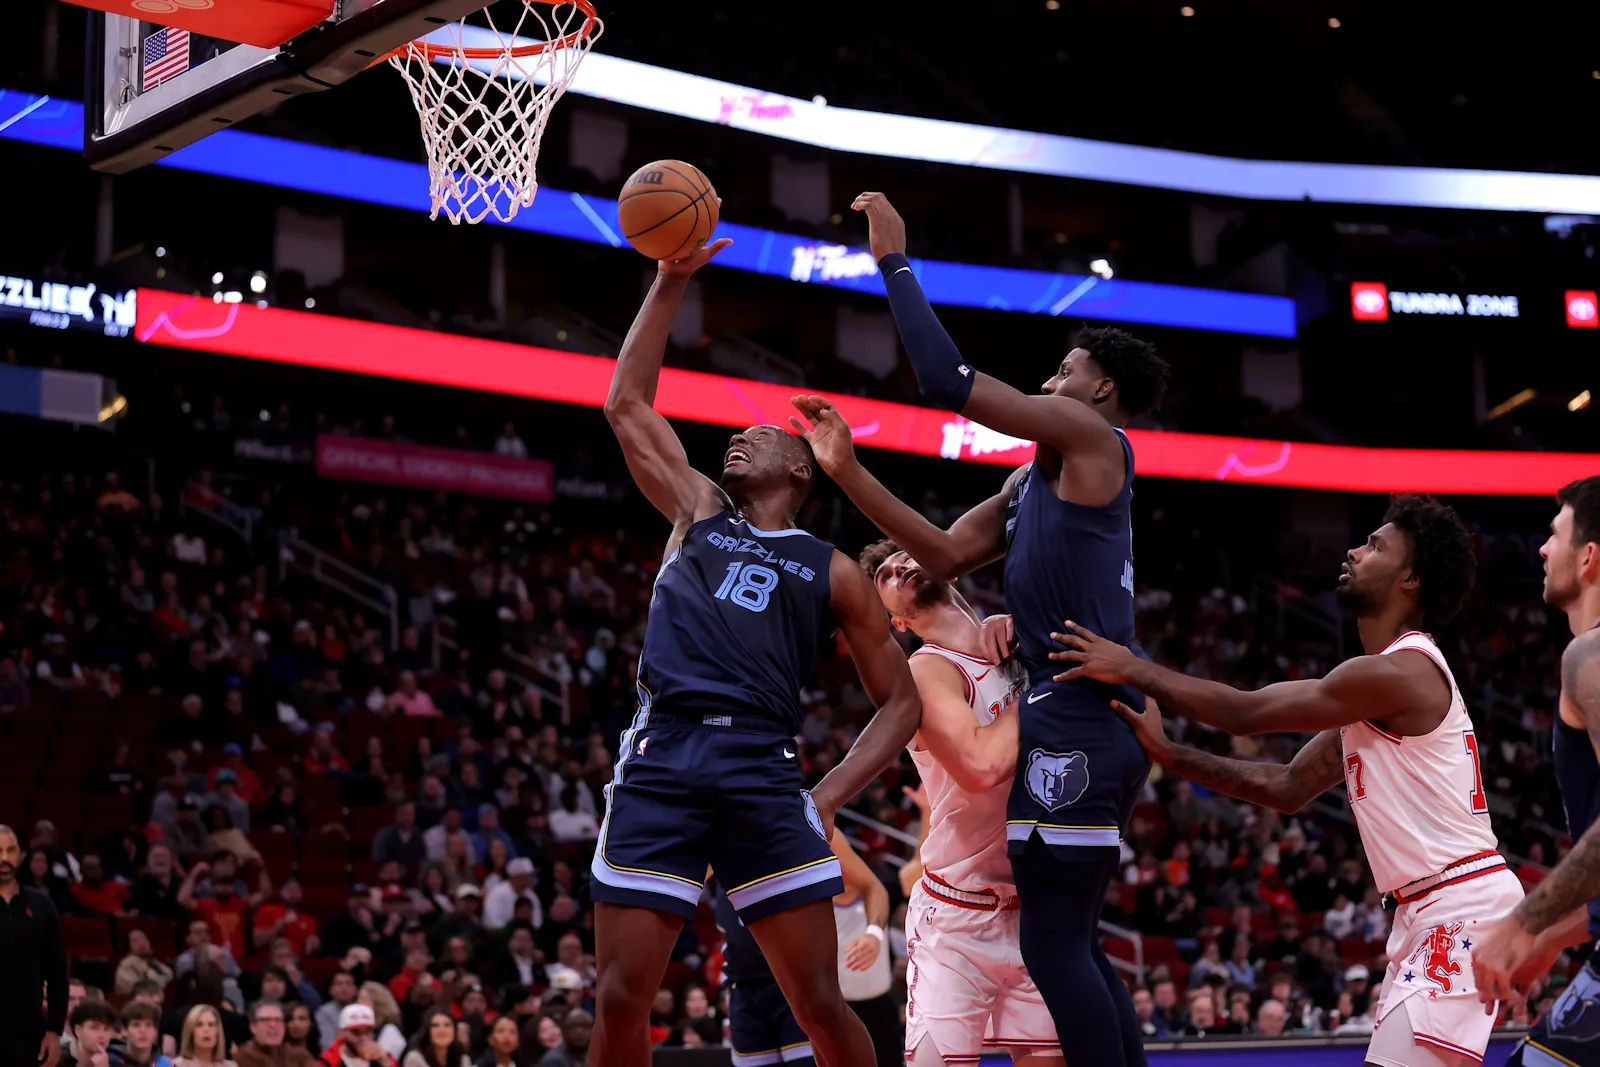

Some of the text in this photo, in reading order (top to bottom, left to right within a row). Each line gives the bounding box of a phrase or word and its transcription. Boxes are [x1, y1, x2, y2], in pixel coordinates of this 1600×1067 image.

[1389, 292, 1519, 317] TUNDRA ZONE
[707, 532, 816, 582] GRIZZLIES
[714, 561, 779, 612] 18
